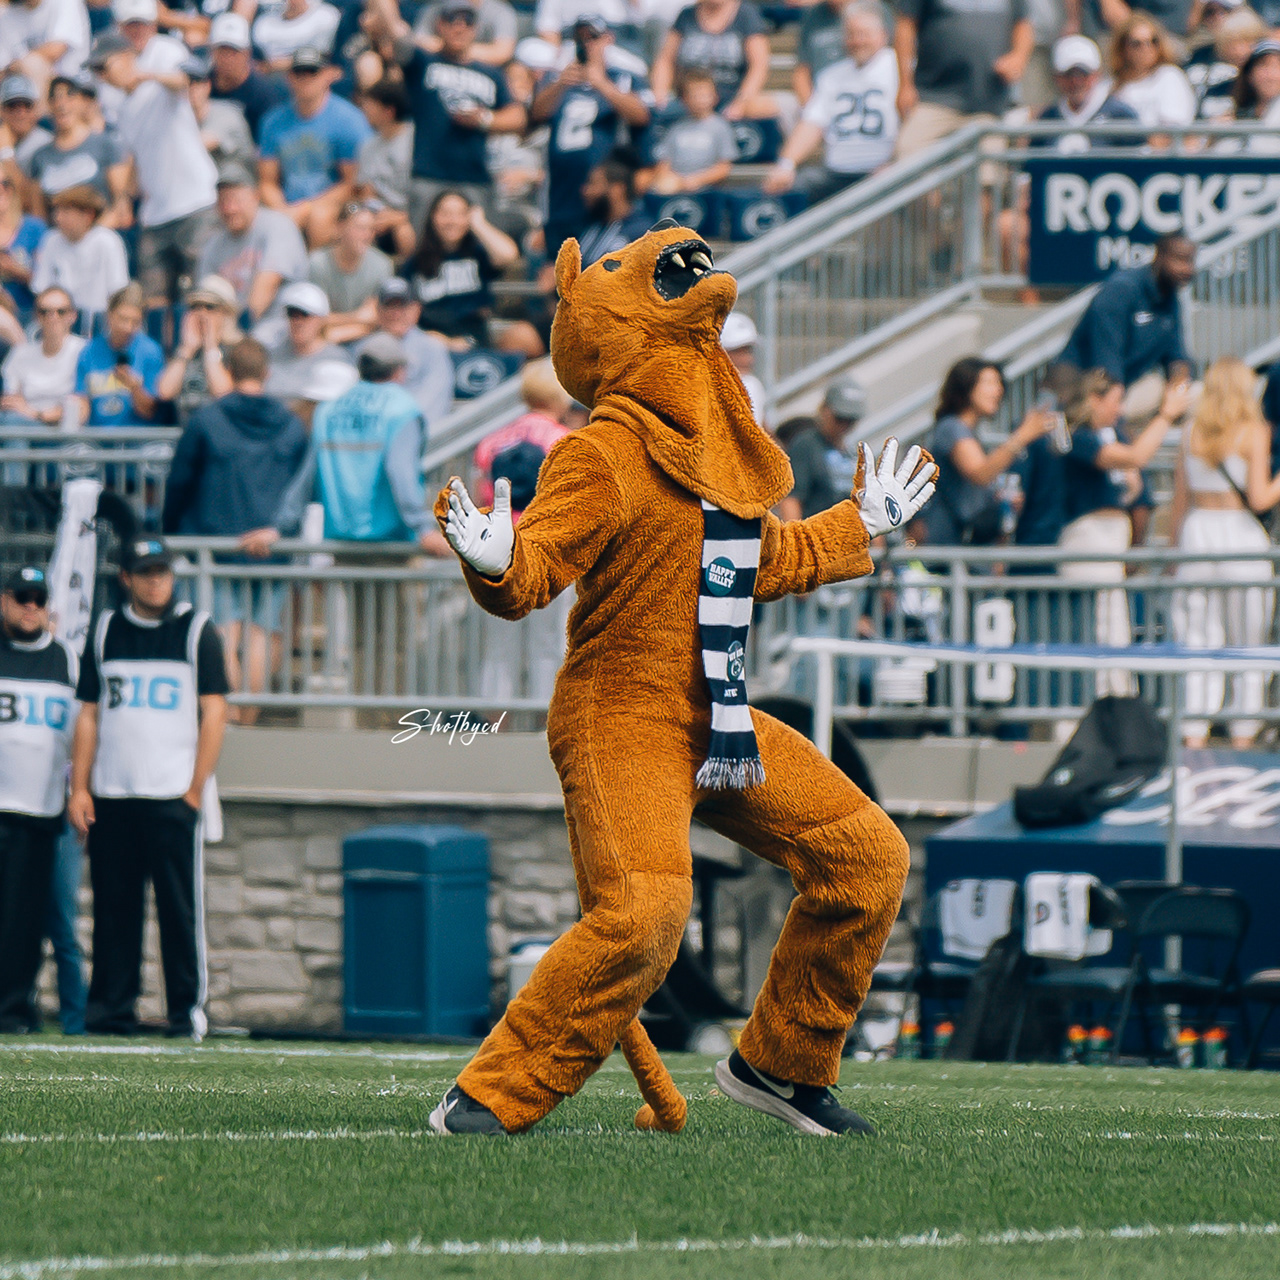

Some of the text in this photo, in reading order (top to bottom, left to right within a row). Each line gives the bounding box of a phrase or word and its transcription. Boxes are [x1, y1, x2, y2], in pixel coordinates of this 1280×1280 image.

[835, 89, 888, 140] 26
[710, 563, 736, 579] HAPPY
[708, 572, 734, 589] VALLEY
